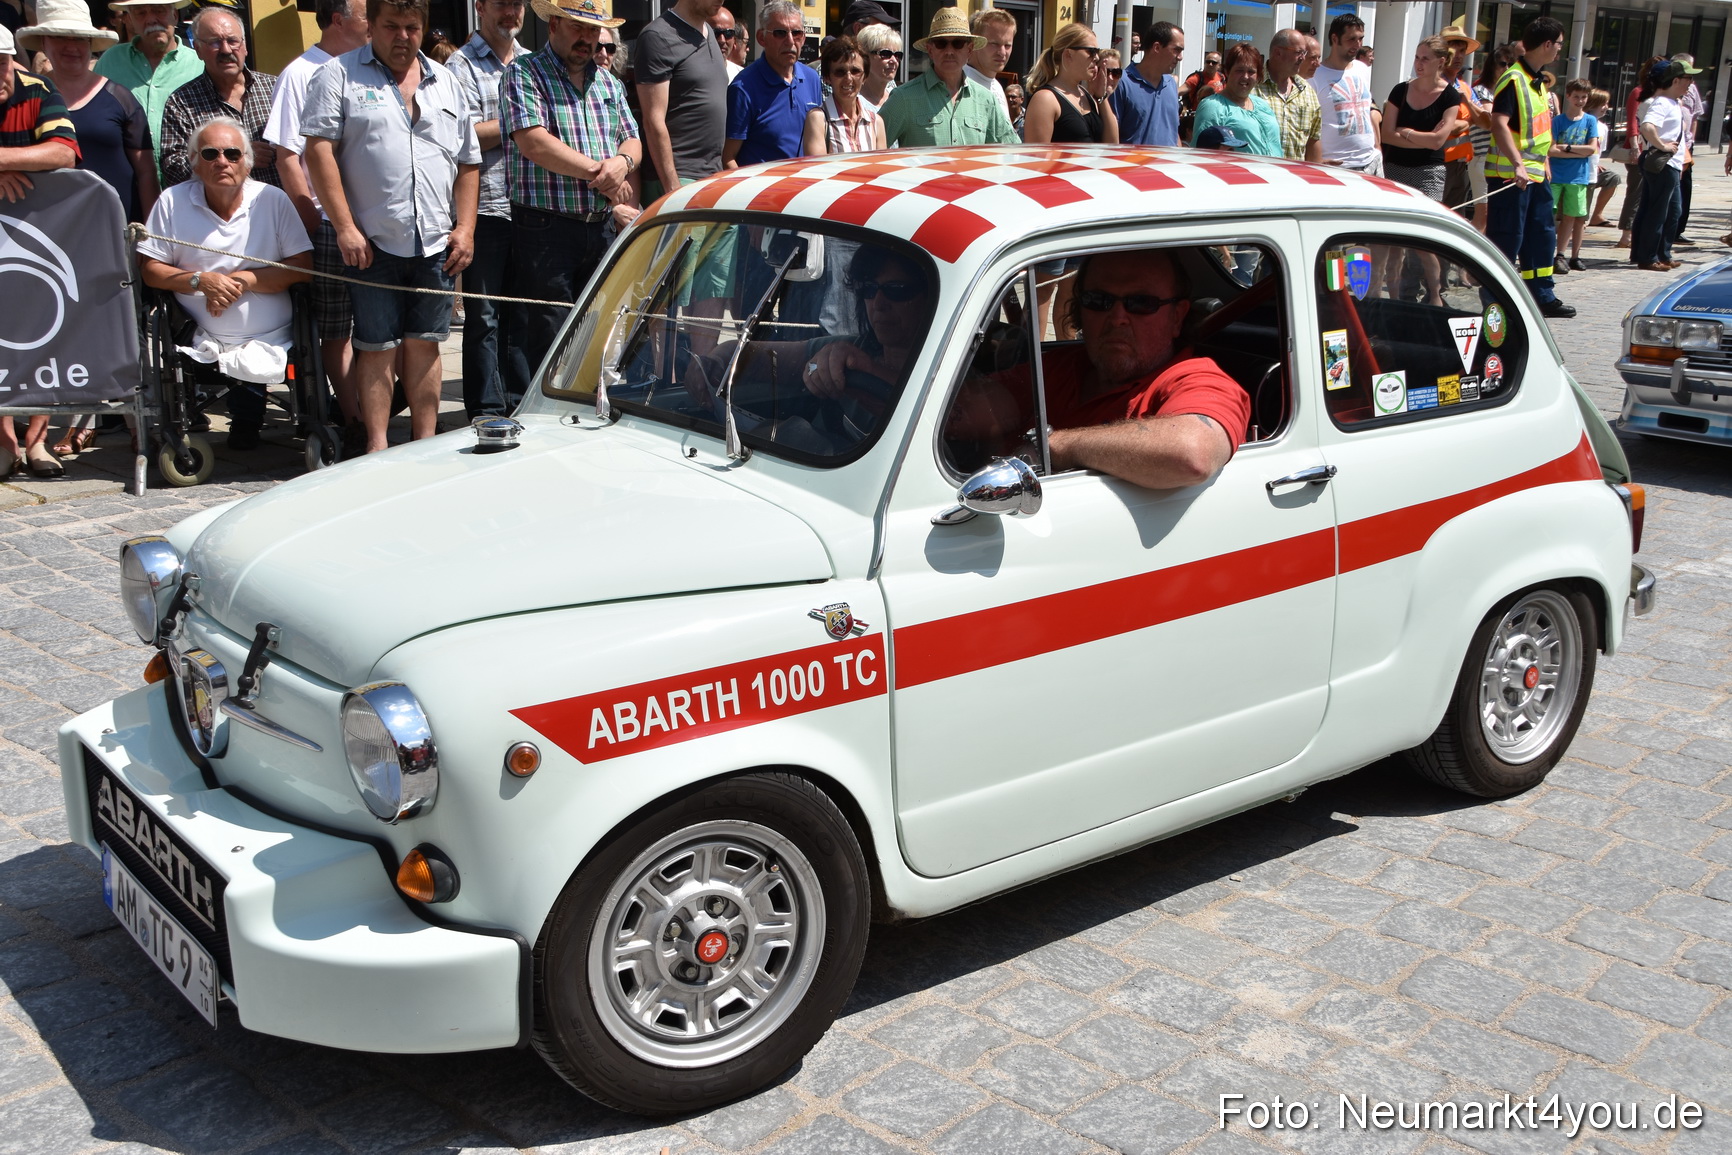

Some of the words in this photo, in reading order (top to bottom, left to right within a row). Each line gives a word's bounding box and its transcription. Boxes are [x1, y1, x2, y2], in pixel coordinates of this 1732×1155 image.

[1060, 5, 1071, 20] 24
[1456, 329, 1477, 337] KONI
[587, 679, 741, 749] ABARTH
[751, 660, 825, 710] 1000
[833, 648, 877, 690] TC
[98, 775, 215, 922] ABARTH
[117, 870, 138, 935] AM
[148, 904, 175, 973] TC
[180, 938, 192, 989] 9
[199, 957, 209, 978] 04
[200, 993, 209, 1013] 10
